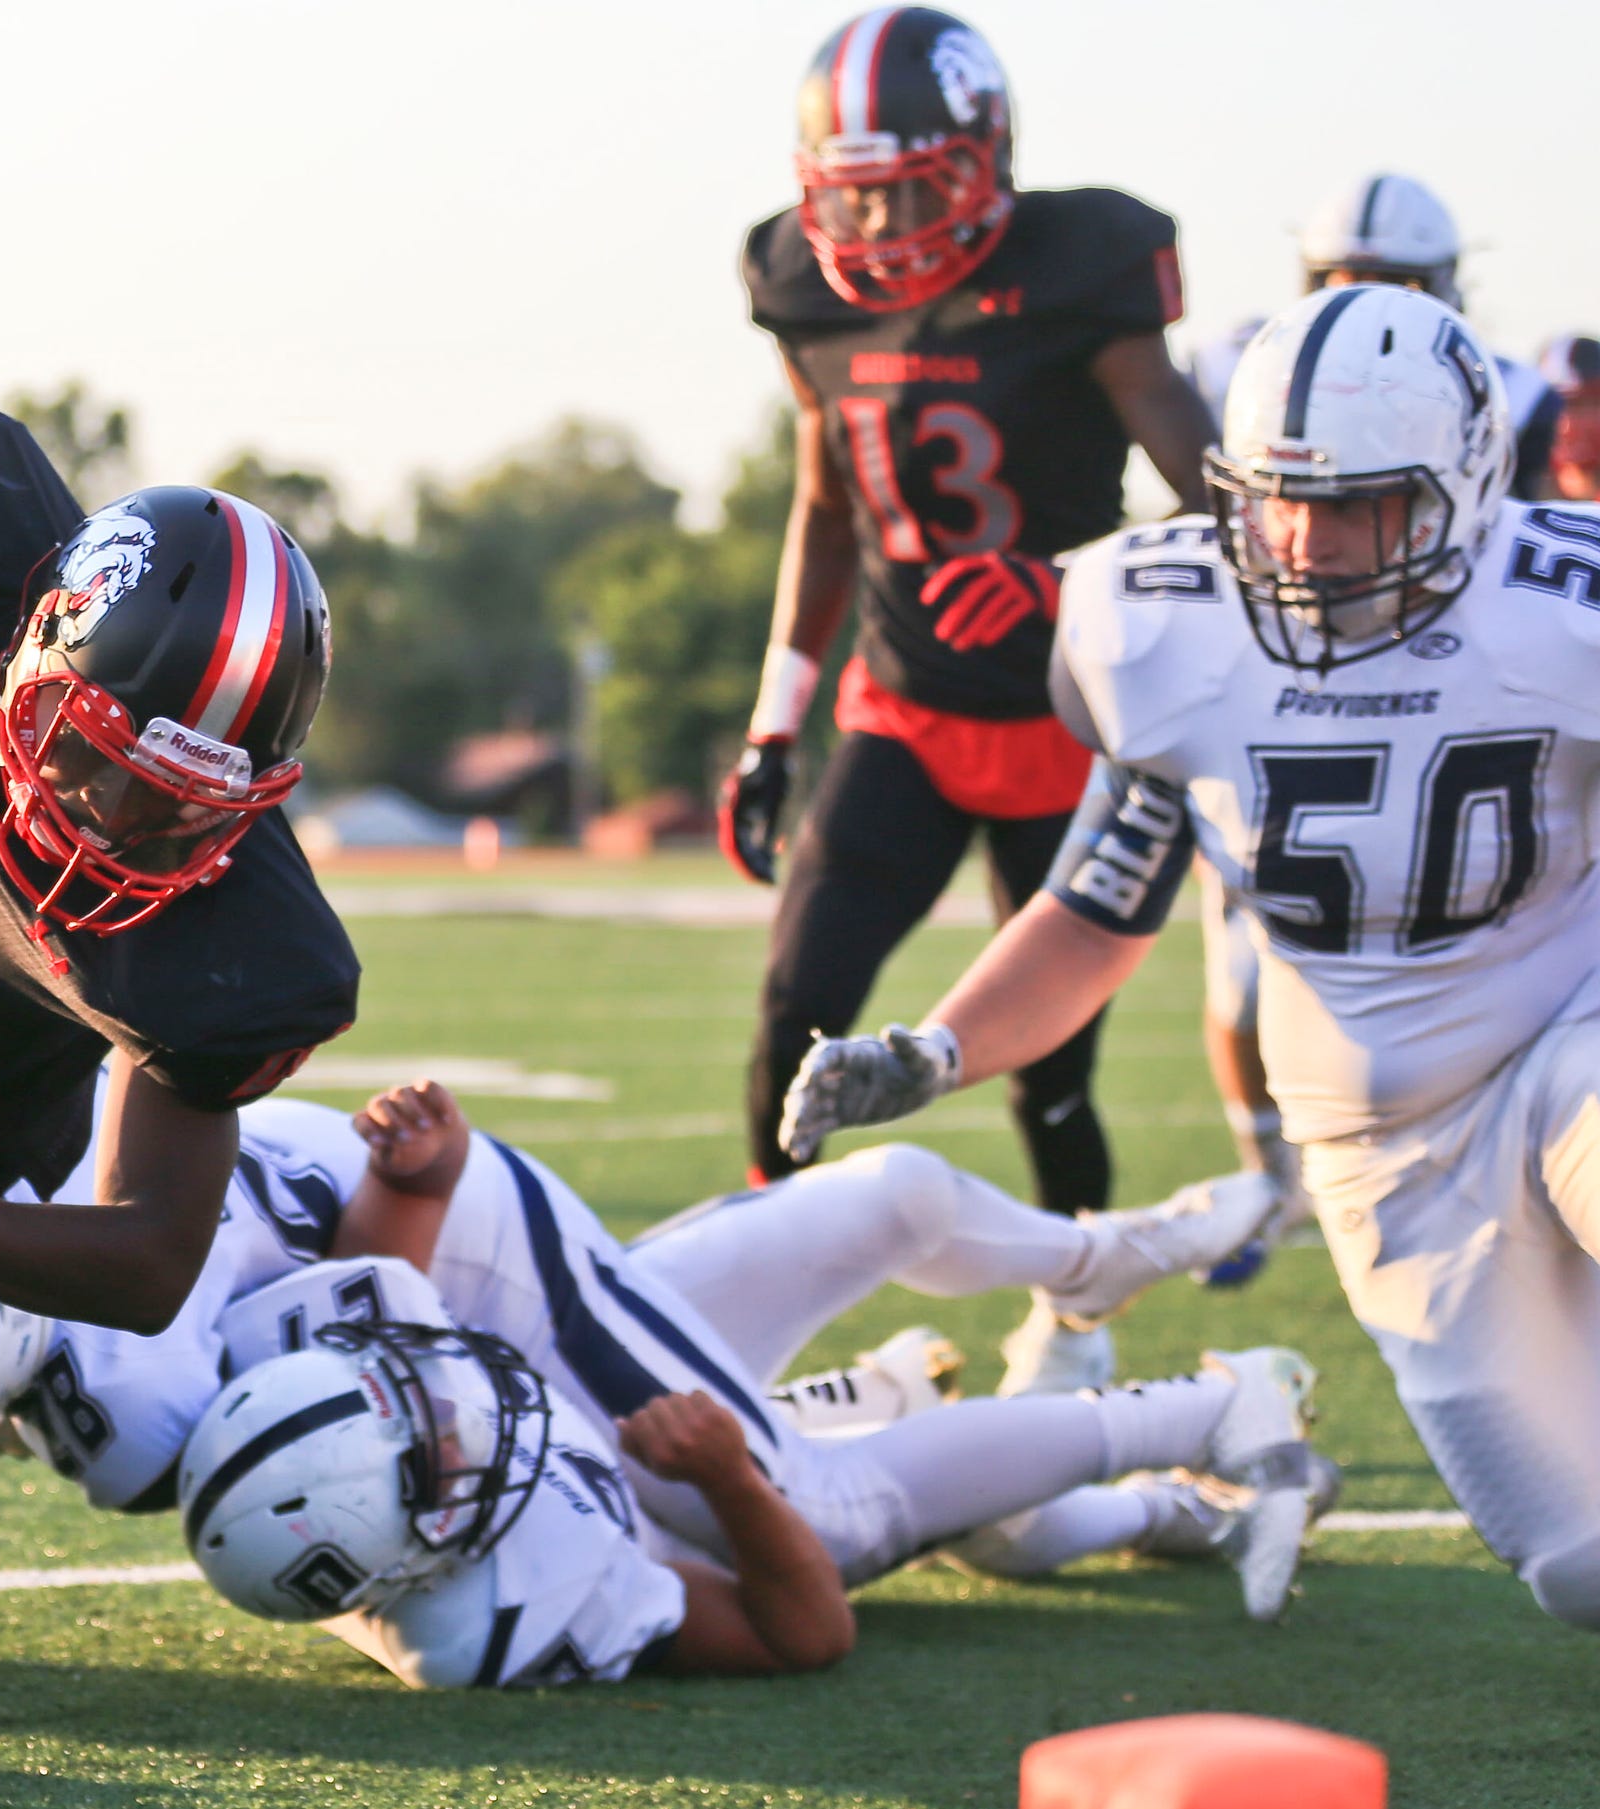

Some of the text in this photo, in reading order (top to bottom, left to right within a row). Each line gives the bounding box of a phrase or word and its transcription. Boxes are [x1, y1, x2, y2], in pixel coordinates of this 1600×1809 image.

[838, 396, 1026, 563] 13
[170, 732, 231, 766] Riddell
[1246, 727, 1558, 957] 50
